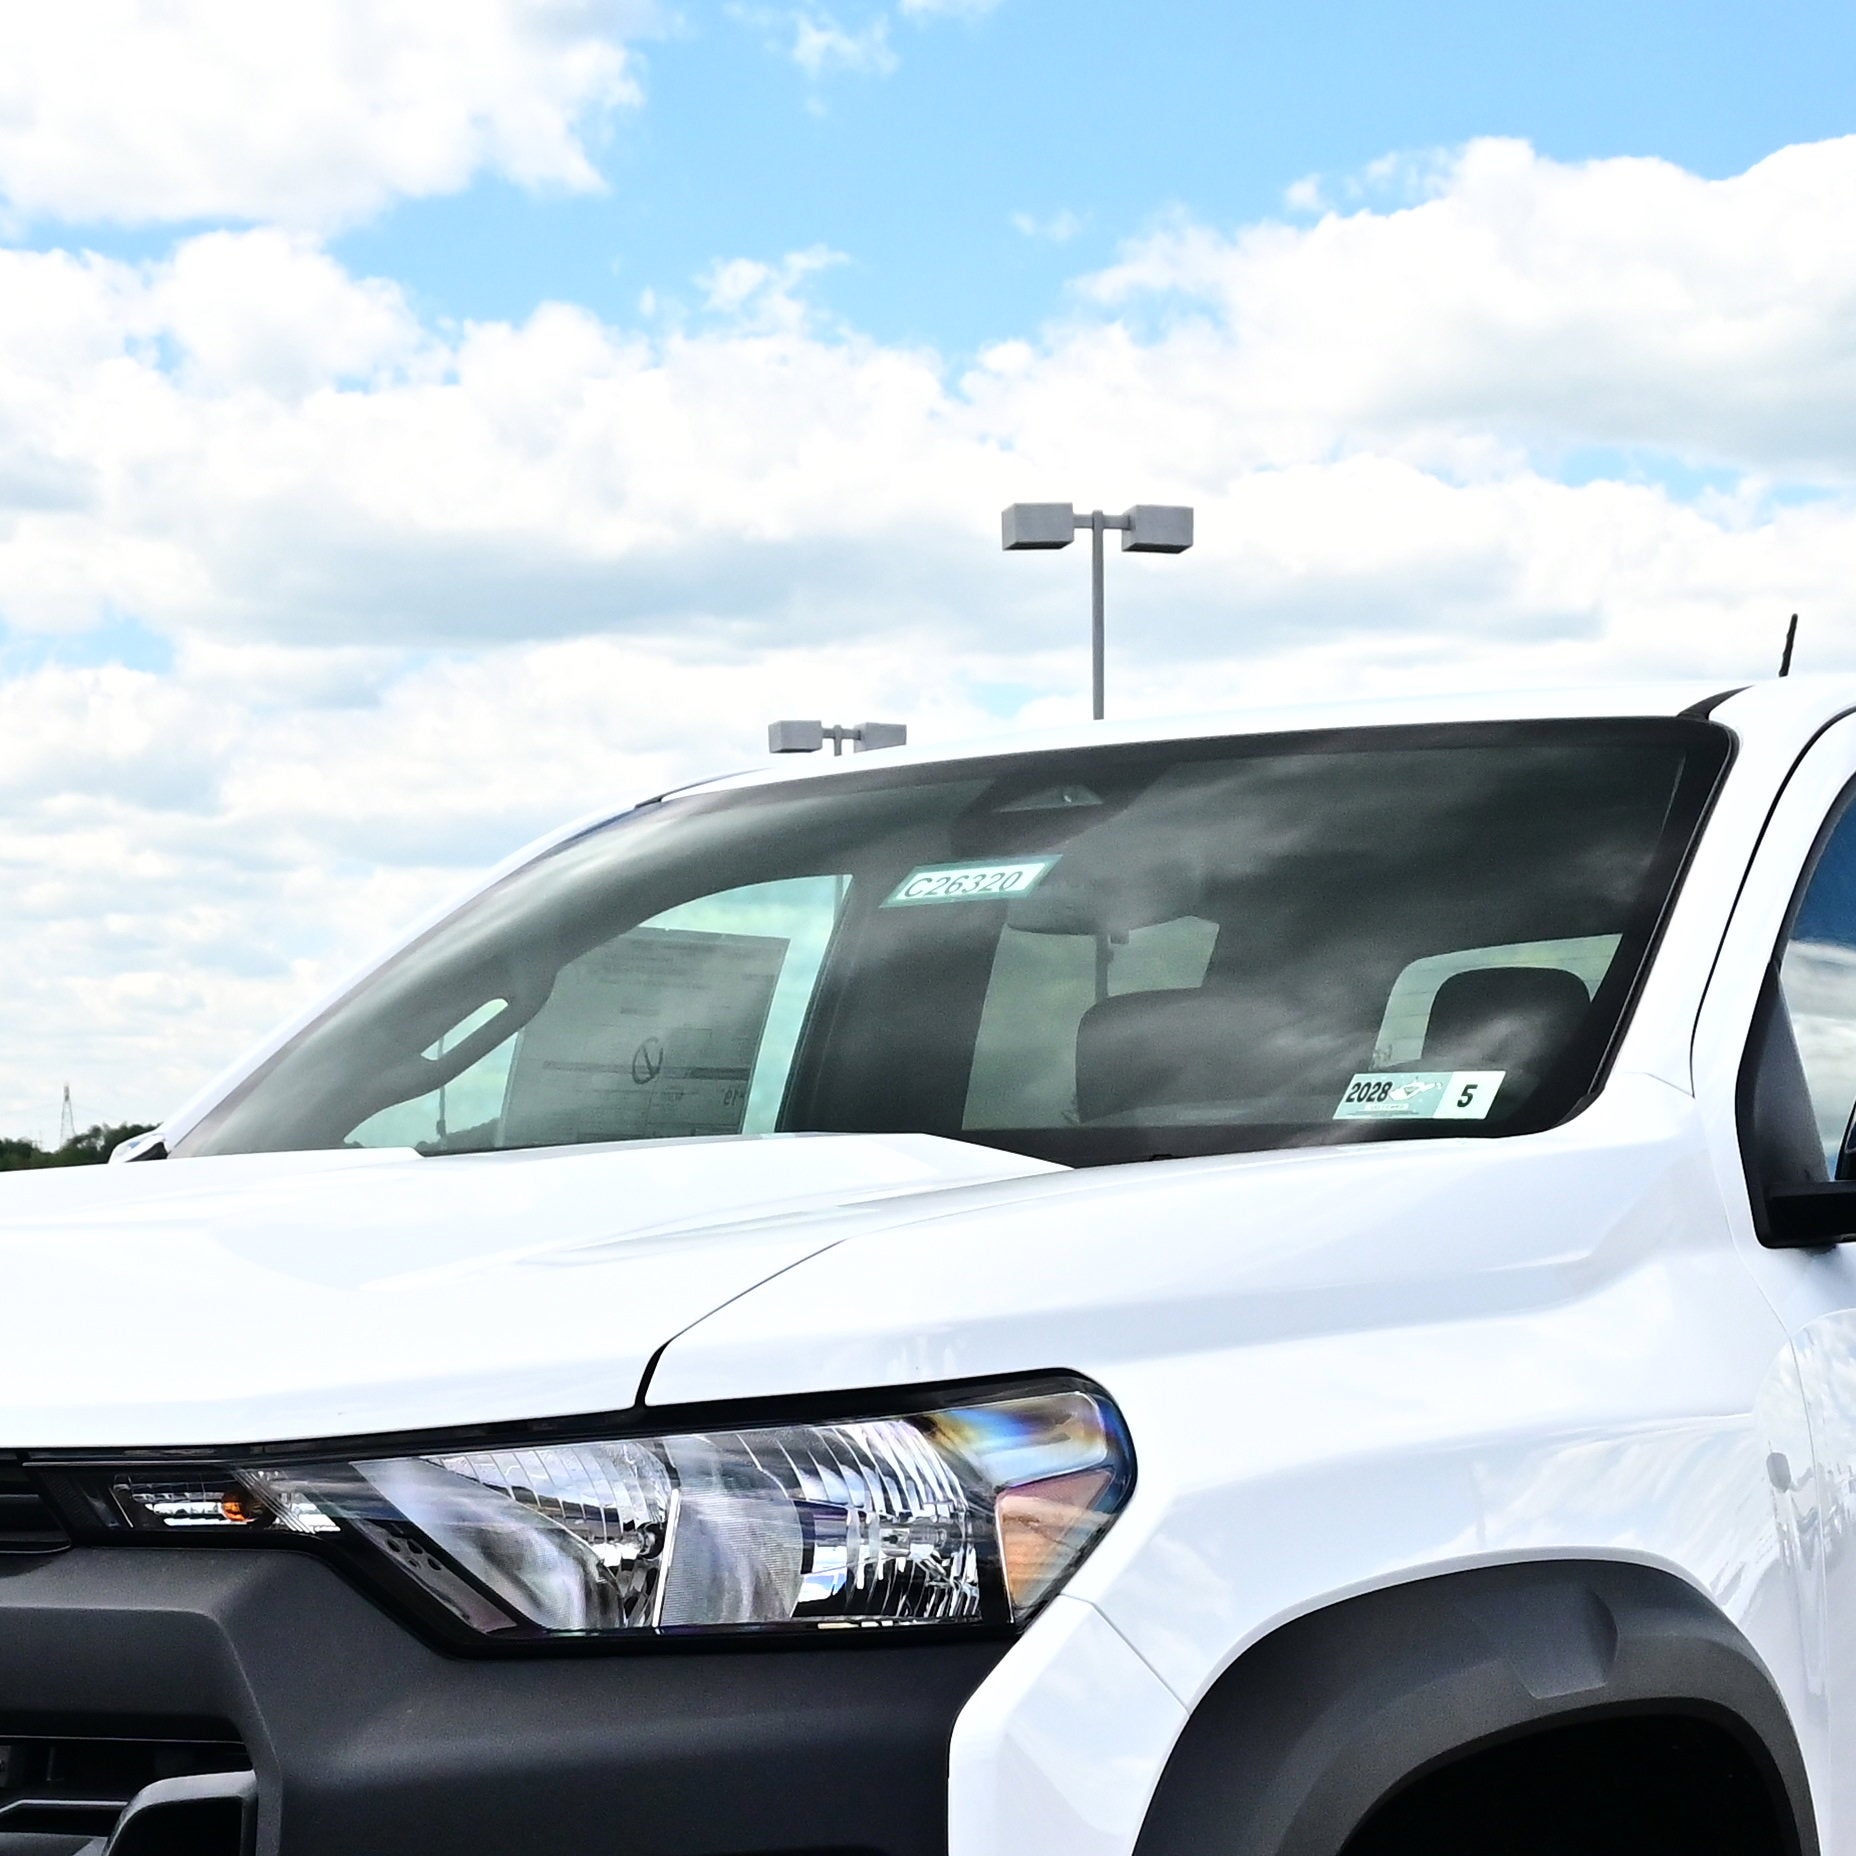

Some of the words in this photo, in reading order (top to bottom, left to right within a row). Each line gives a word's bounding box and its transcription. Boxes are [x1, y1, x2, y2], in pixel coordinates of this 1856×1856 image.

[904, 870, 1023, 898] C26320
[1345, 1081, 1394, 1103] 2028
[1456, 1083, 1479, 1108] 5
